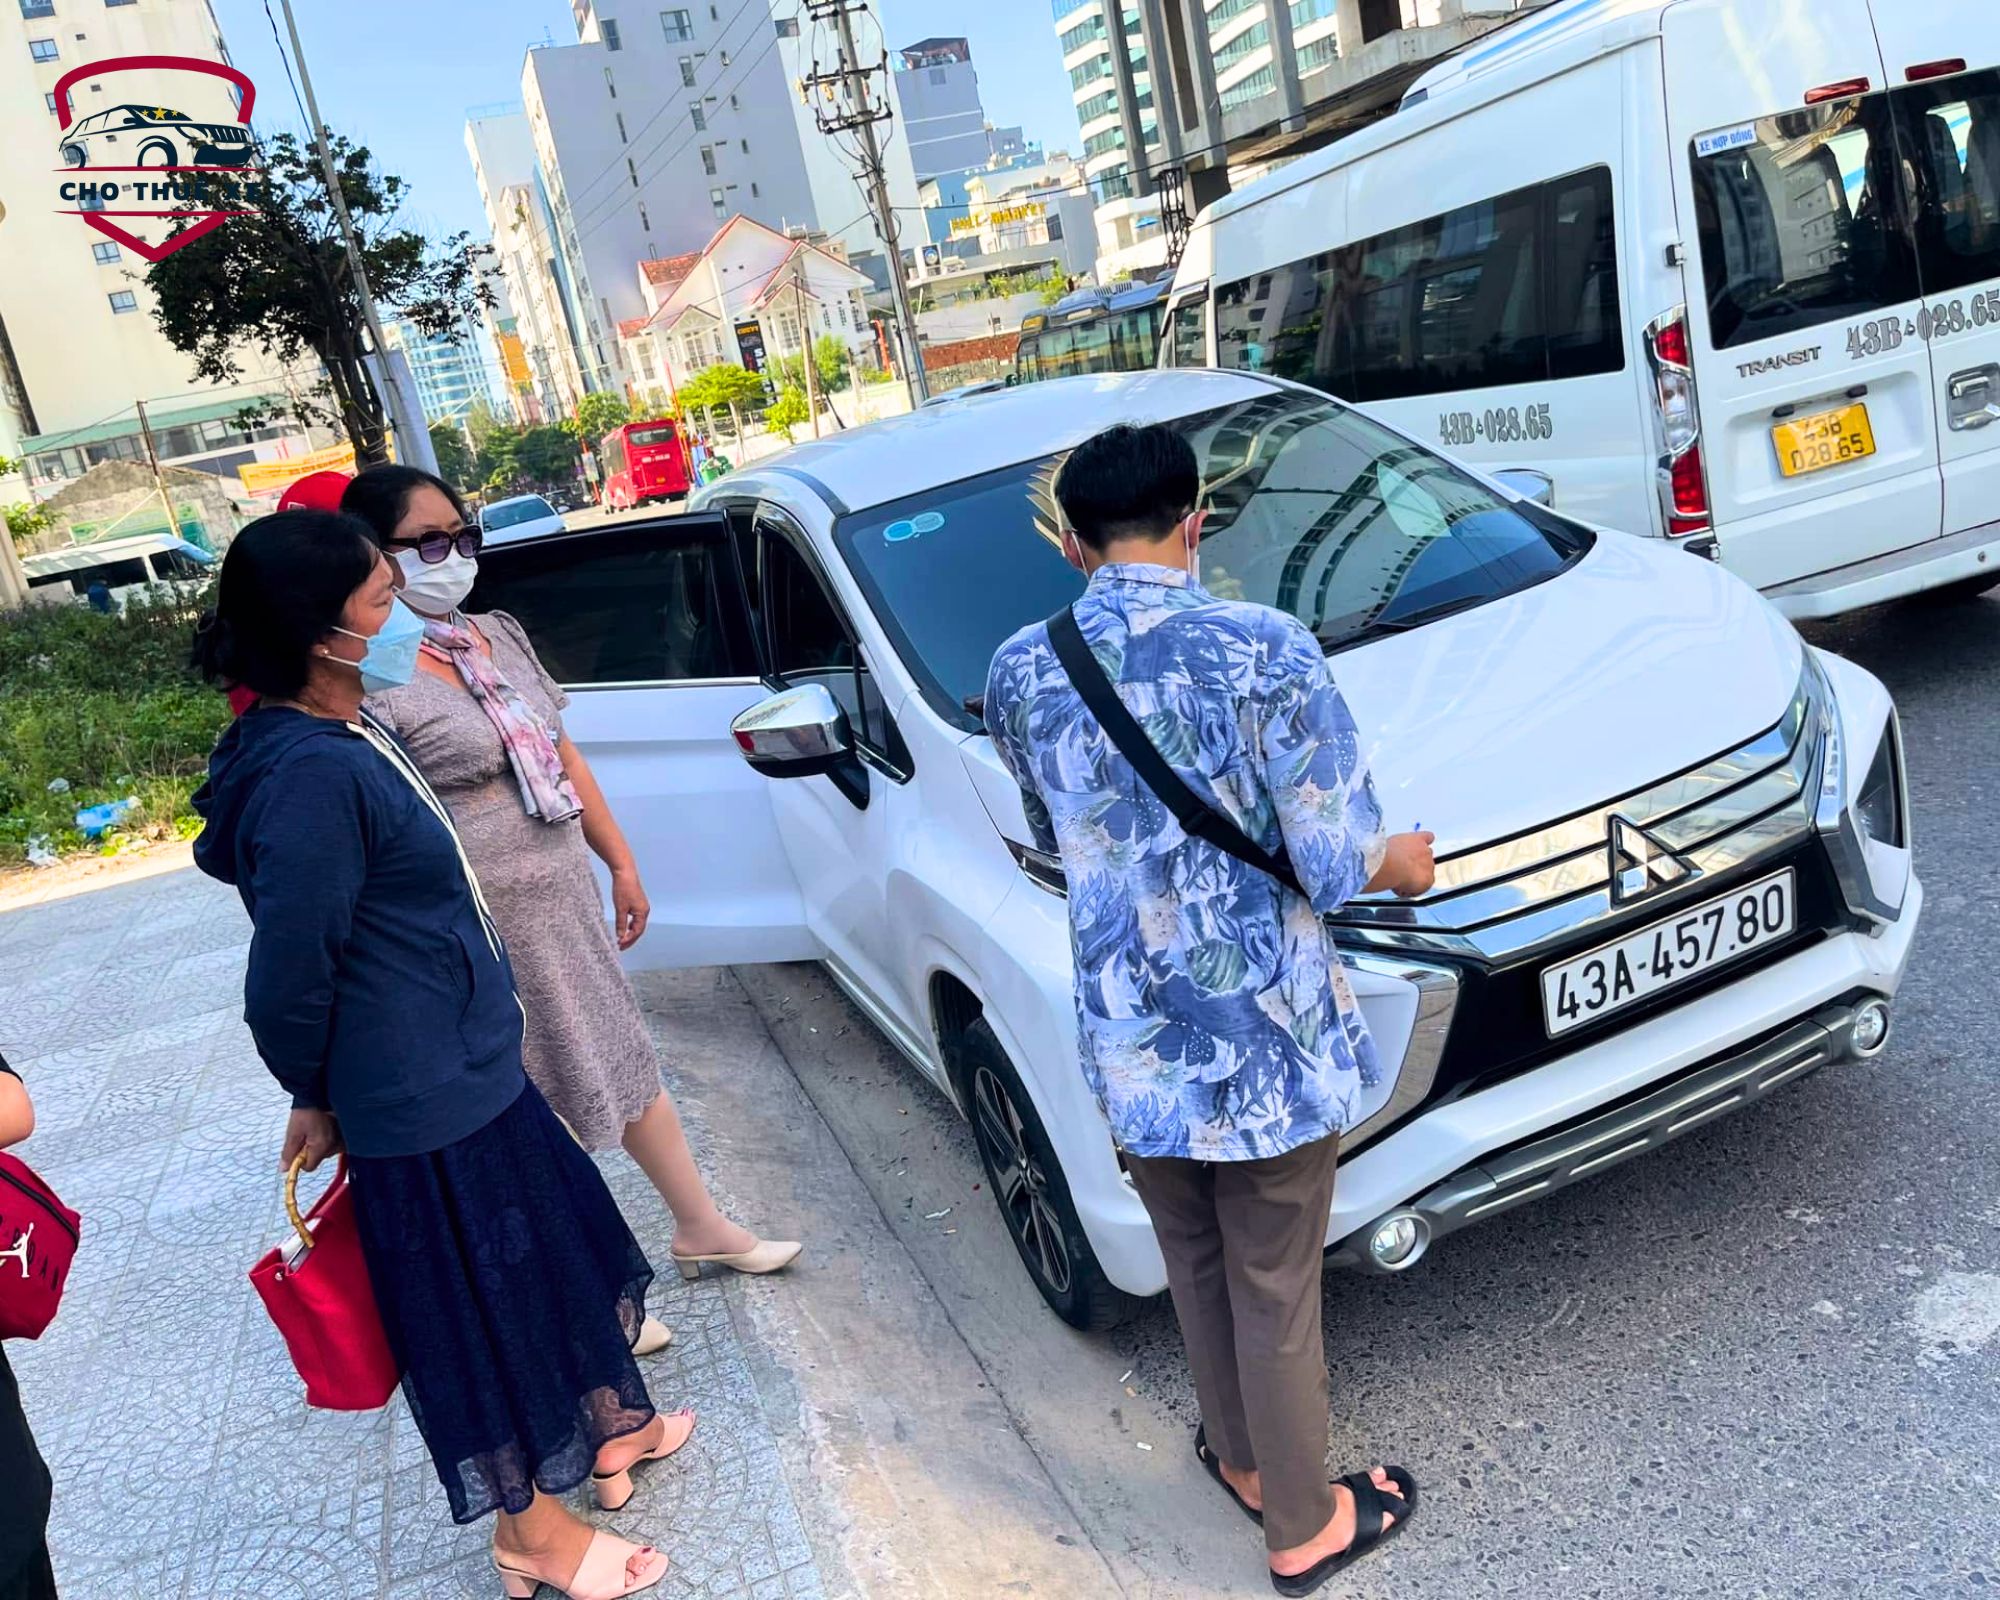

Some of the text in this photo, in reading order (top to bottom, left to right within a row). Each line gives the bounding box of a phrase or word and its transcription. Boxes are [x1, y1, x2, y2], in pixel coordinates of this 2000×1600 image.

[1699, 139, 1711, 152] XE
[1736, 346, 1822, 378] TRANSIT
[1791, 432, 1865, 470] 028.65
[1557, 884, 1785, 1019] 43A-457.80
